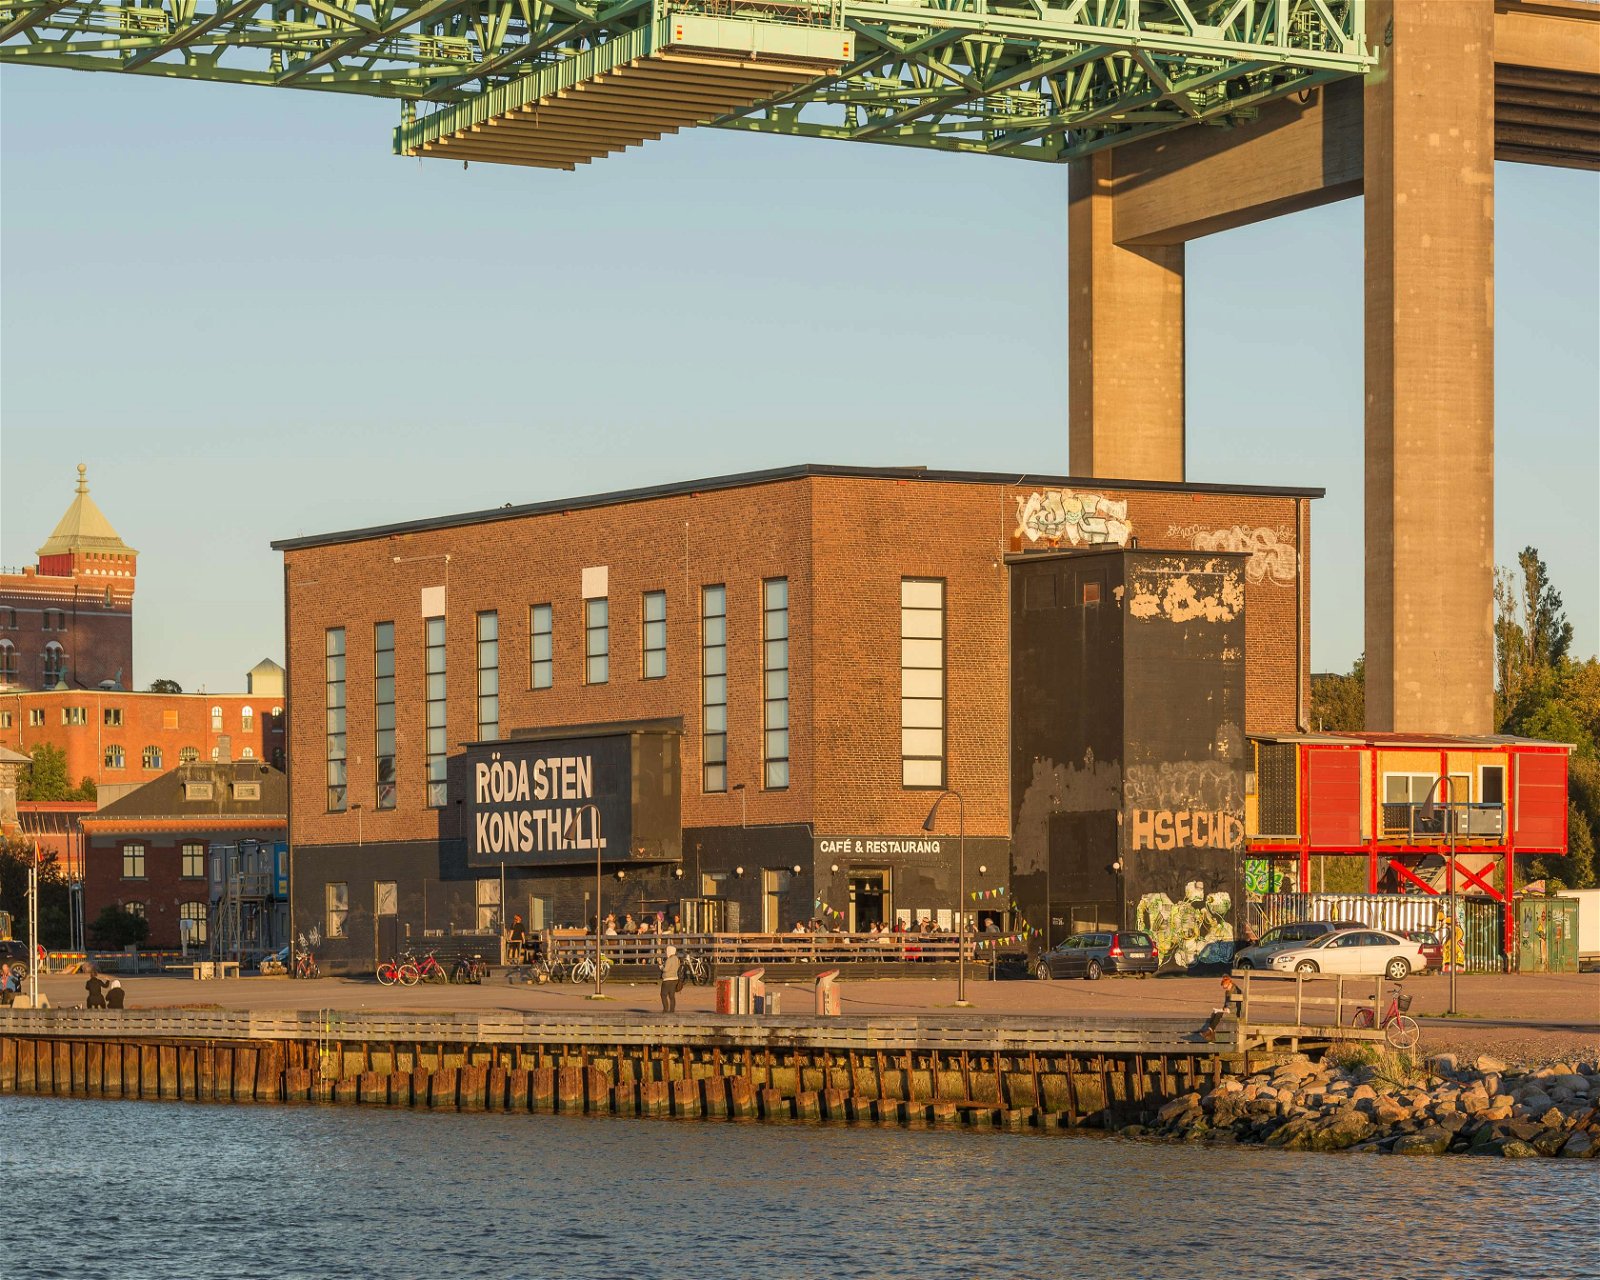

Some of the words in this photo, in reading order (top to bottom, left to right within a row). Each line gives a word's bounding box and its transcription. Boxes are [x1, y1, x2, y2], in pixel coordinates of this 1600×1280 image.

[476, 752, 530, 803] RÖDA
[533, 755, 593, 800] STEN
[476, 806, 607, 853] KONSTHALL
[820, 839, 851, 853] CAFÉ
[855, 840, 864, 853] &
[866, 840, 940, 854] RESTAURANG
